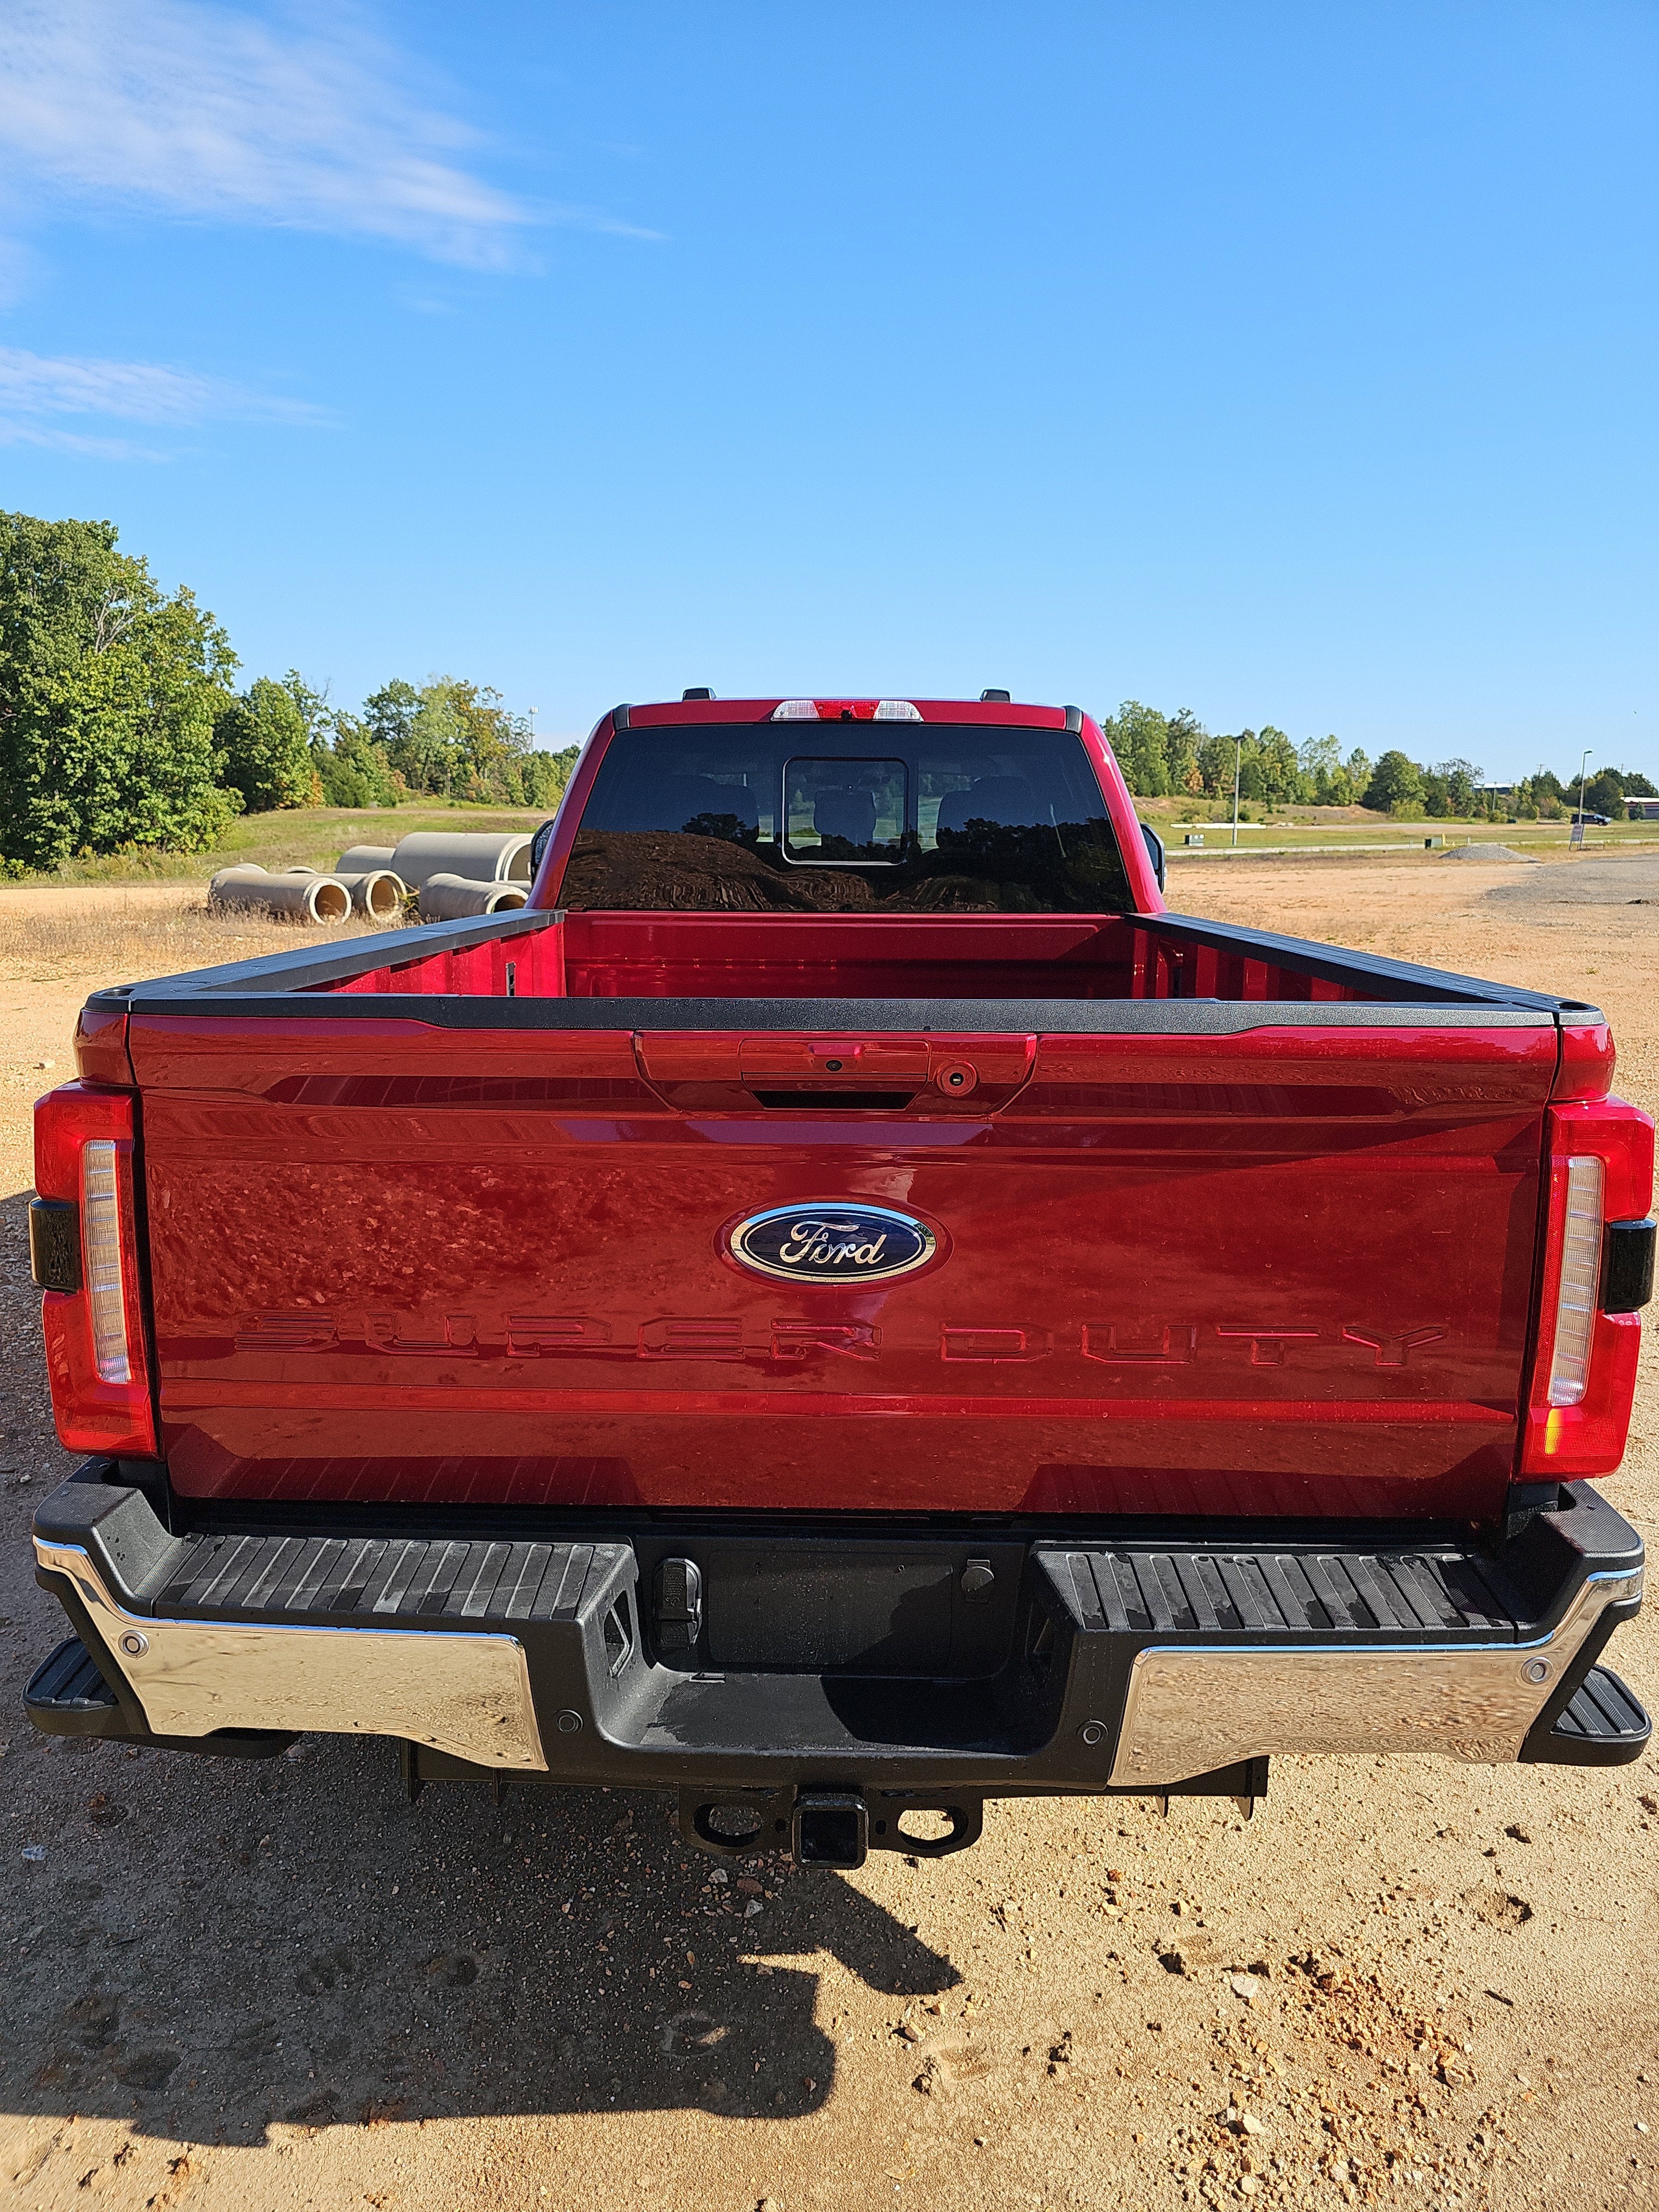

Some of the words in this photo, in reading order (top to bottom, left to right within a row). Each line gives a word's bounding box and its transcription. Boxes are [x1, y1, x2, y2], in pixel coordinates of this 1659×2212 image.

[779, 1220, 888, 1264] Ford
[234, 1311, 882, 1360] SUPER
[940, 1323, 1448, 1366] DUTY
